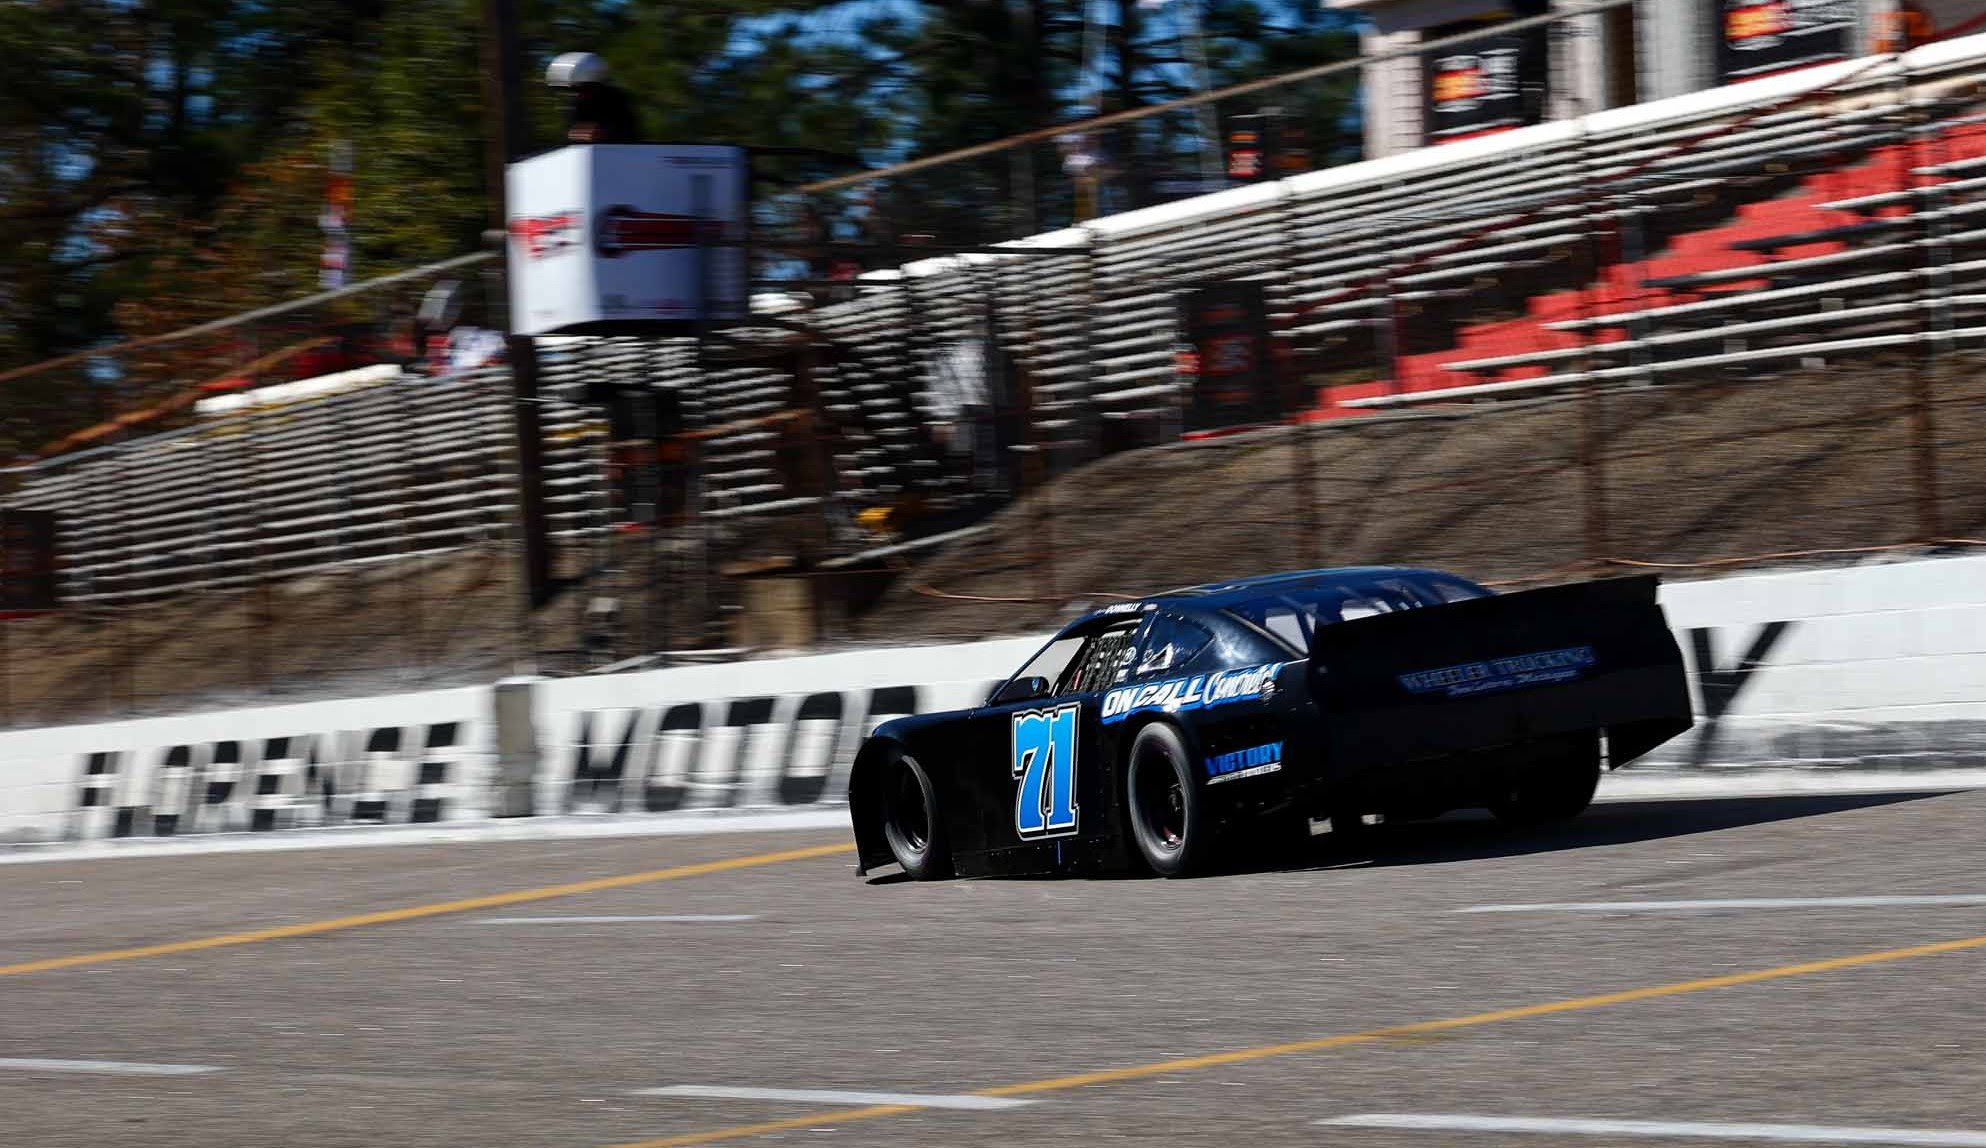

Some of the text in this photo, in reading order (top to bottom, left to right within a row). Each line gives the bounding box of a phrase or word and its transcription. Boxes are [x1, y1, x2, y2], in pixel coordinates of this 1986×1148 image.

[70, 720, 463, 840] FLORENCE
[1012, 702, 1080, 841] 71
[1204, 740, 1285, 777] VICTORY
